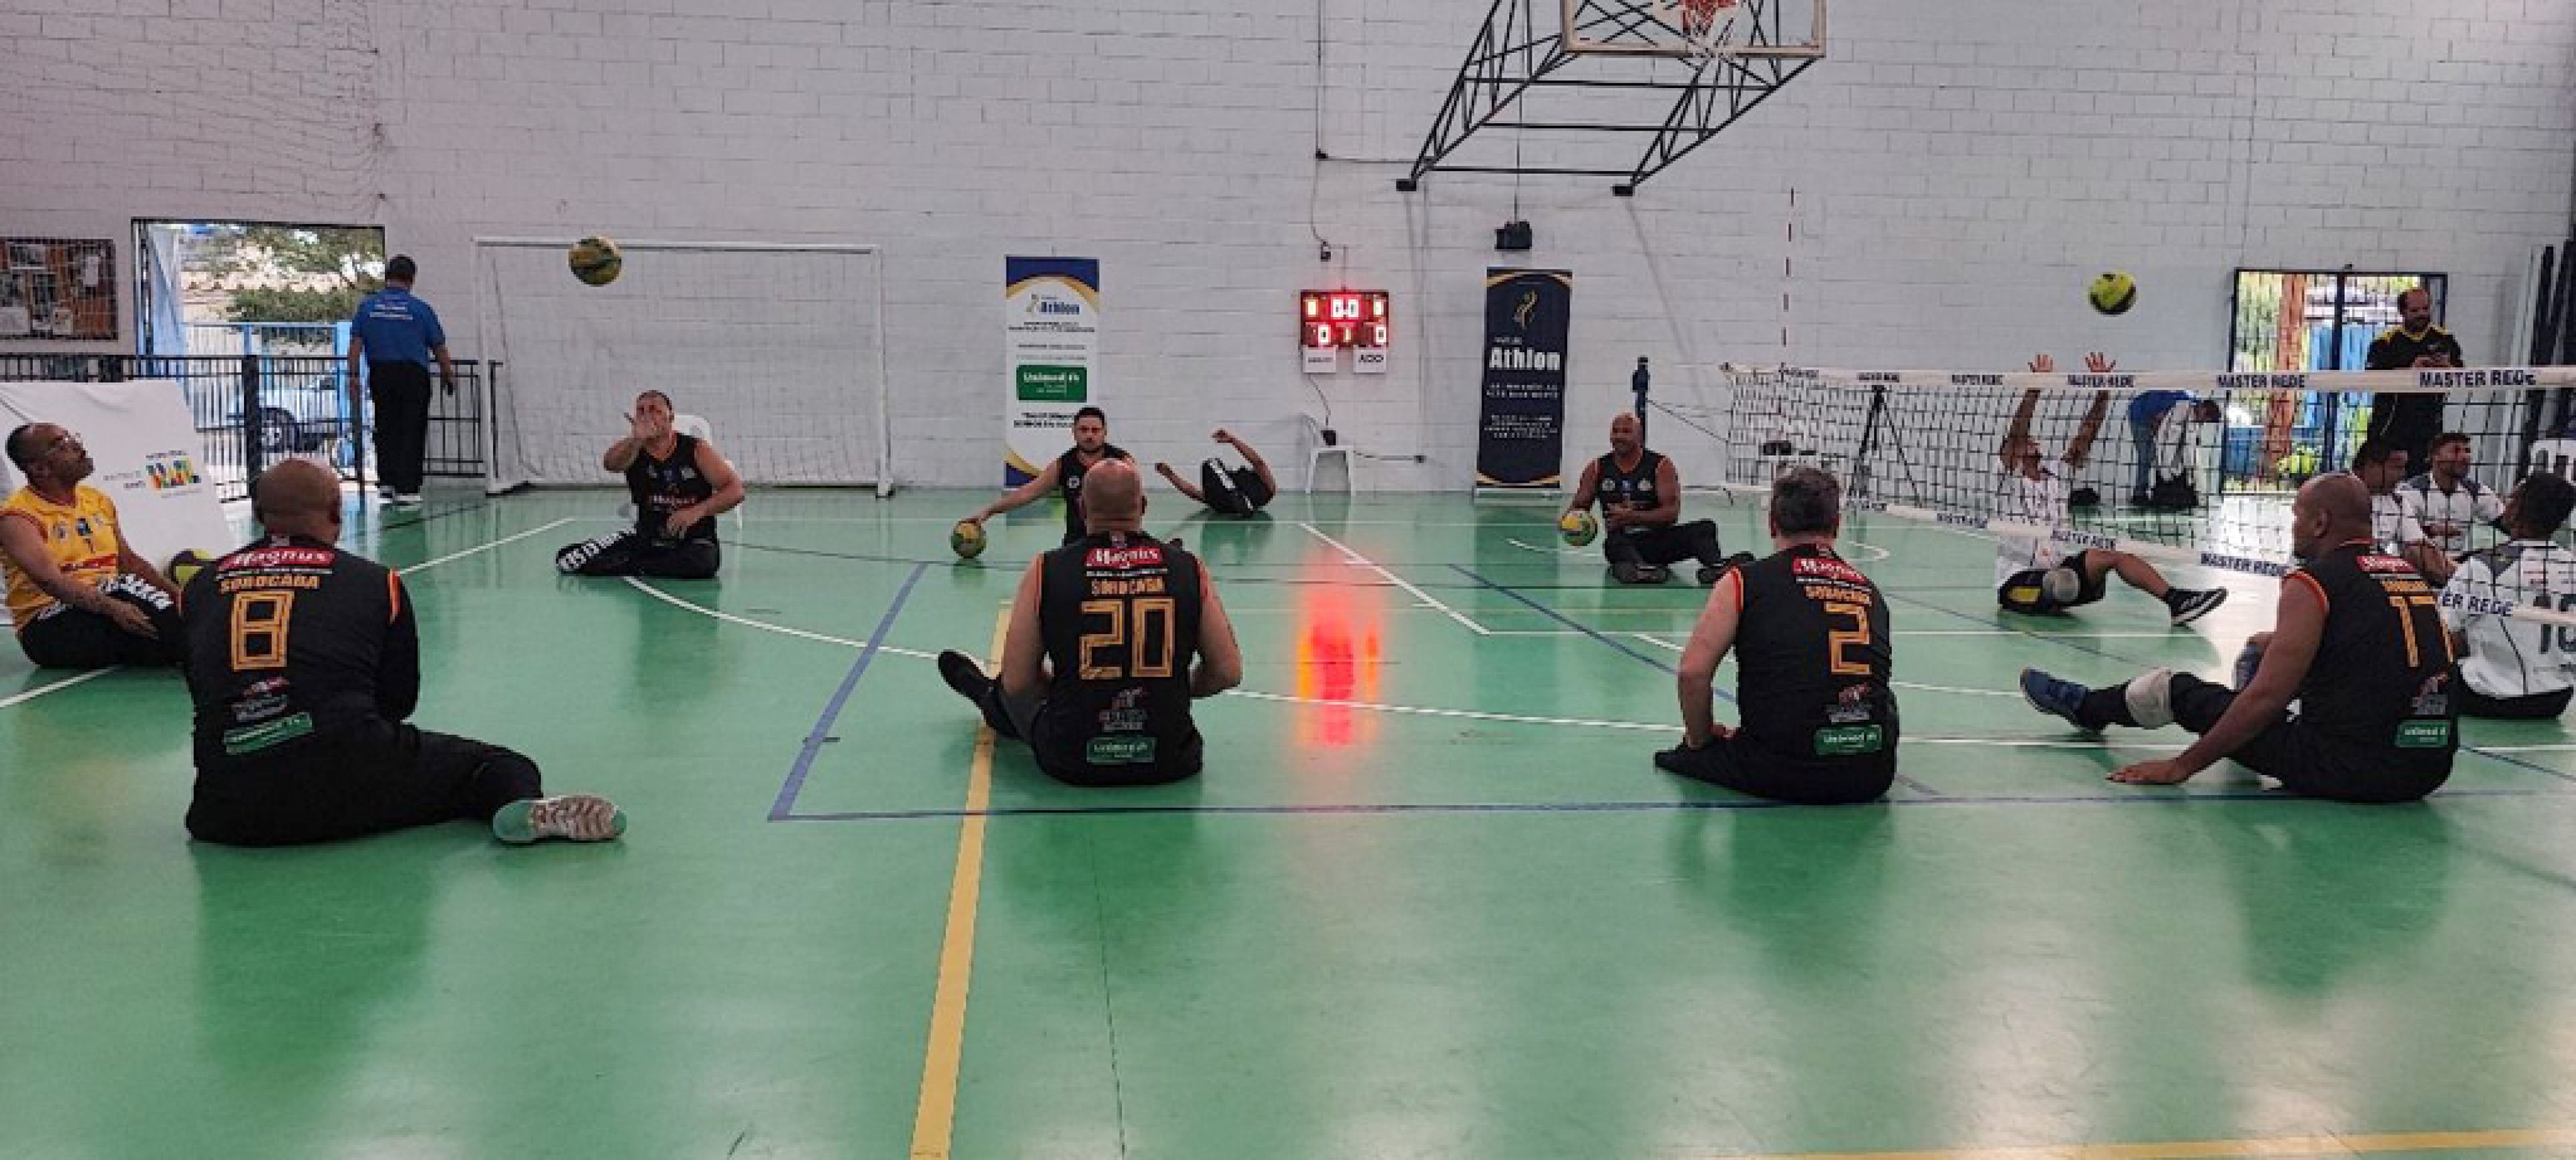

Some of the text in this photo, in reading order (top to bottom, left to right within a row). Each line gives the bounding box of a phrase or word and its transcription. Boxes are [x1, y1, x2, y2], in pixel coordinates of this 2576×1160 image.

[1489, 347, 1560, 370] Athlon
[2217, 374, 2305, 388] MASTER REDE
[2420, 372, 2486, 387] MASTER
[222, 549, 328, 568] Magnus
[1087, 549, 1160, 569] Magnus
[2200, 552, 2251, 571] MASTER
[220, 574, 319, 593] SOROCABA
[2467, 596, 2513, 618] REDE
[231, 590, 295, 672] 8
[1079, 597, 1175, 680] 20
[1824, 602, 1872, 675] 2
